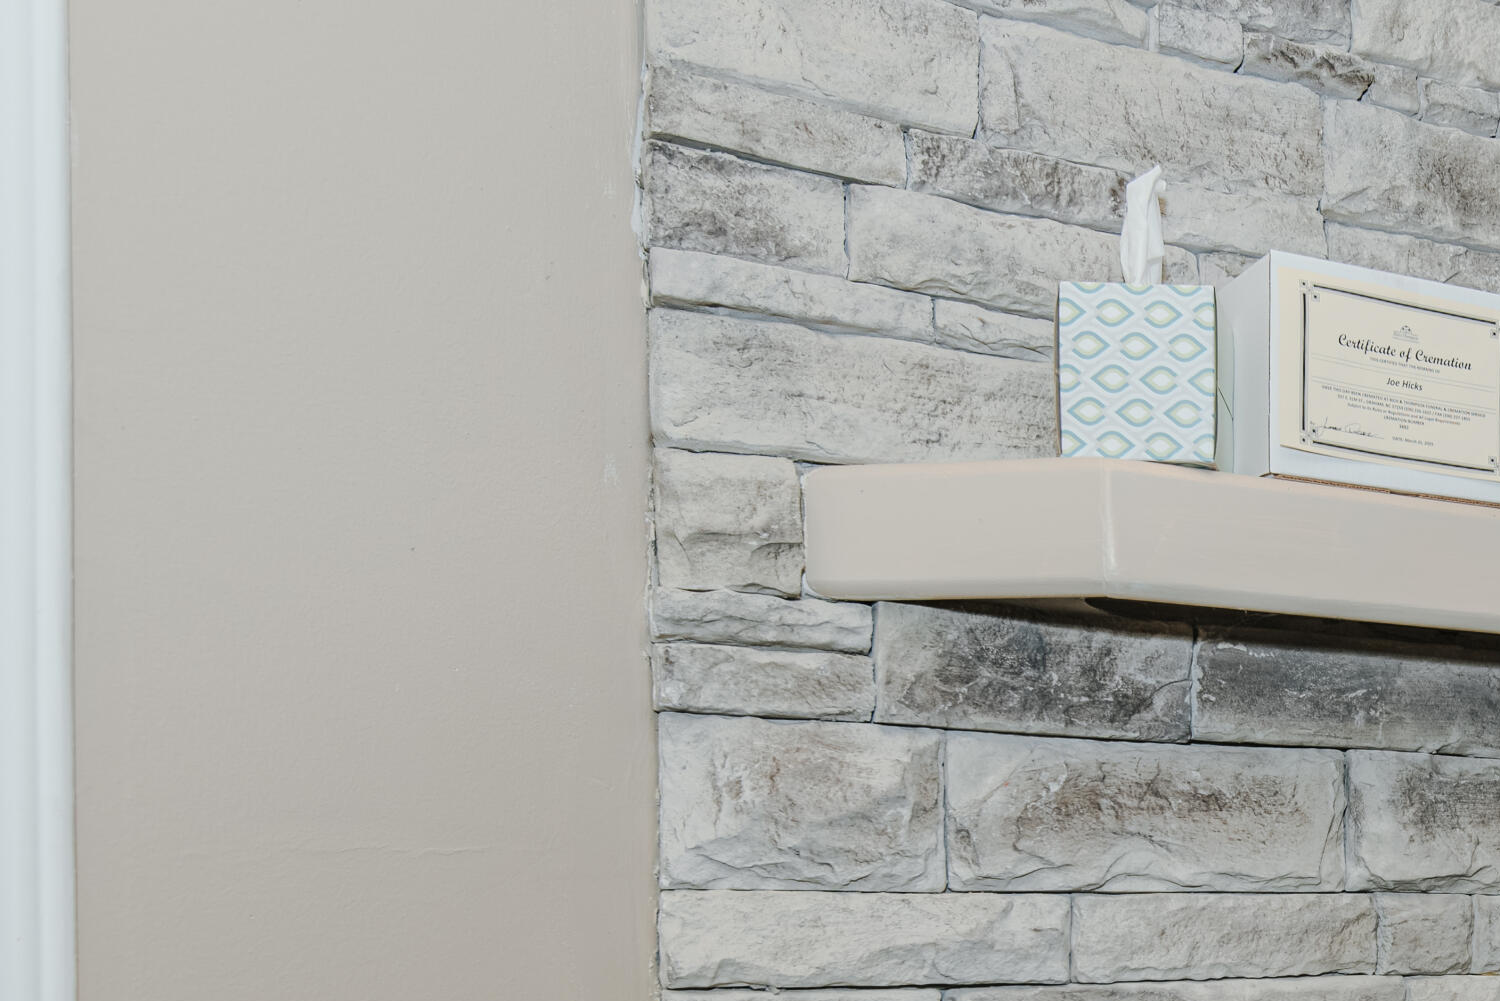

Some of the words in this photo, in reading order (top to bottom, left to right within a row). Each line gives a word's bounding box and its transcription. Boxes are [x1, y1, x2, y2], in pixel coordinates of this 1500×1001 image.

[1338, 333, 1396, 357] Certificate
[1399, 348, 1412, 362] of
[1415, 349, 1472, 371] Cremation
[1386, 377, 1400, 387] Joe
[1402, 379, 1423, 391] Hicks
